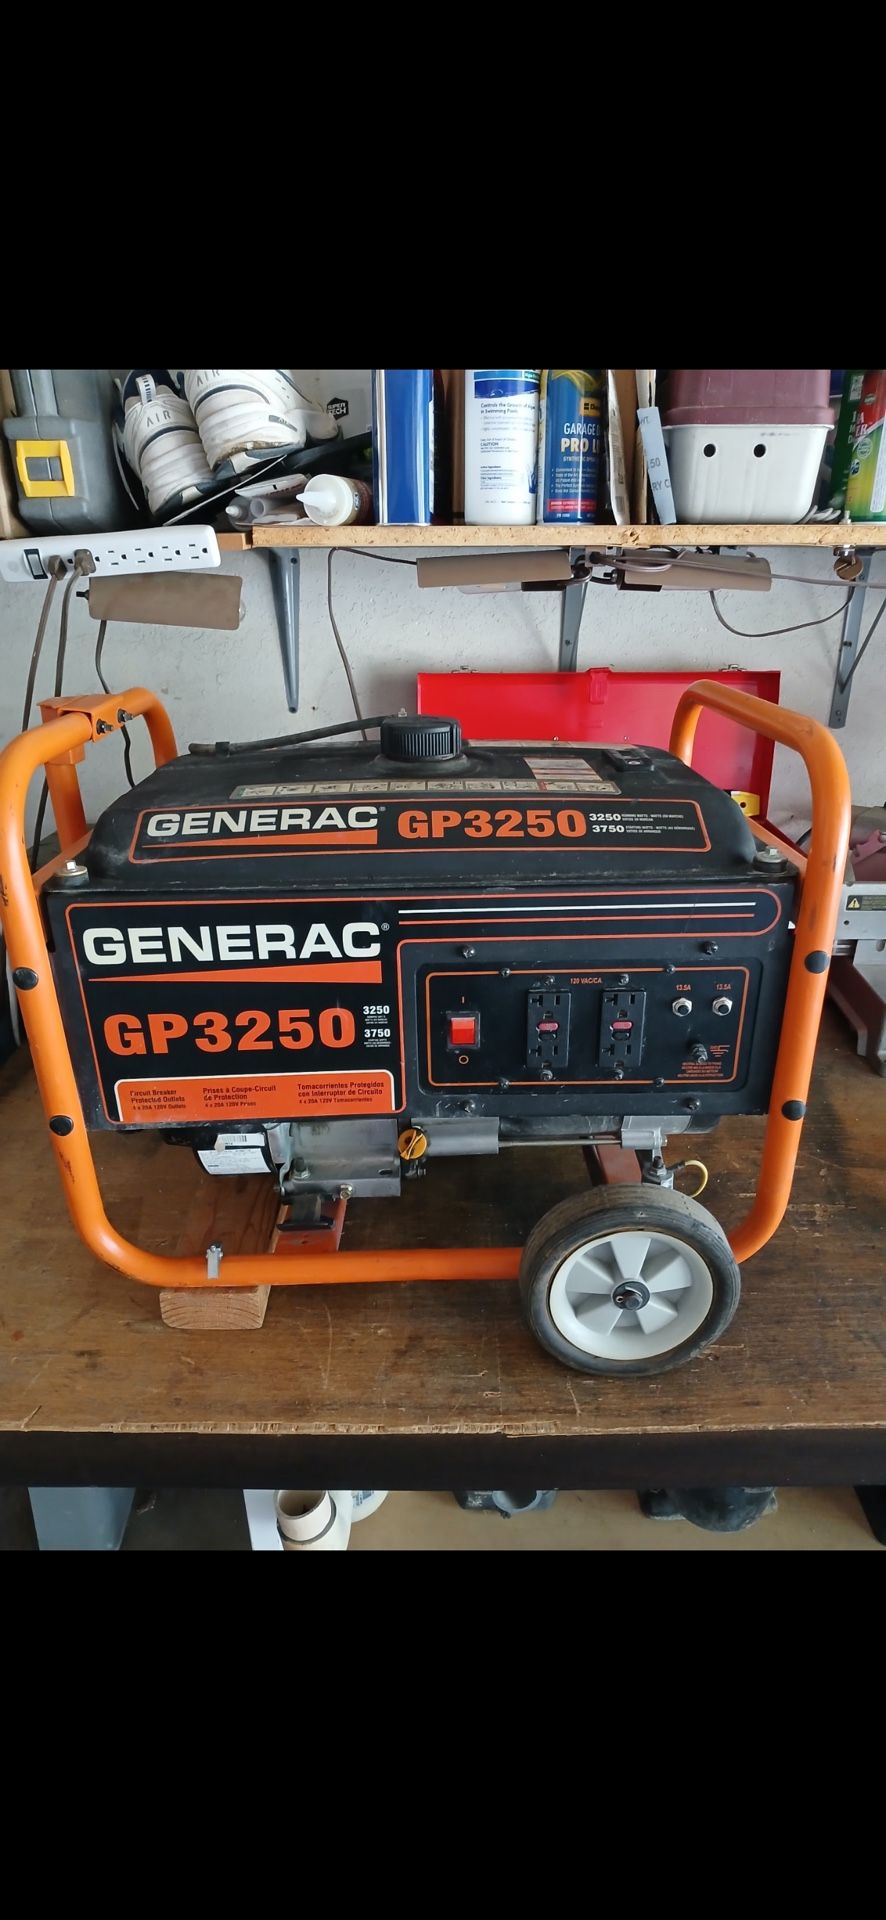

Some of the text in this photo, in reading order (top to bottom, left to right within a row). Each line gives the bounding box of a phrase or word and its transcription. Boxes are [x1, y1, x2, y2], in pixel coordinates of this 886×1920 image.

[146, 410, 171, 428] AIR
[563, 422, 596, 436] GARAGE
[560, 438, 590, 453] PRO
[146, 806, 378, 837] GENERAC
[396, 809, 587, 838] GP3250
[588, 813, 622, 821] 3250
[592, 824, 625, 833] 3750
[82, 922, 381, 965] GENERAC
[362, 1006, 390, 1014] 3250
[103, 1007, 356, 1056] GP3250
[364, 1028, 391, 1038] 3750
[231, 1085, 276, 1094] Coupe-Circuit
